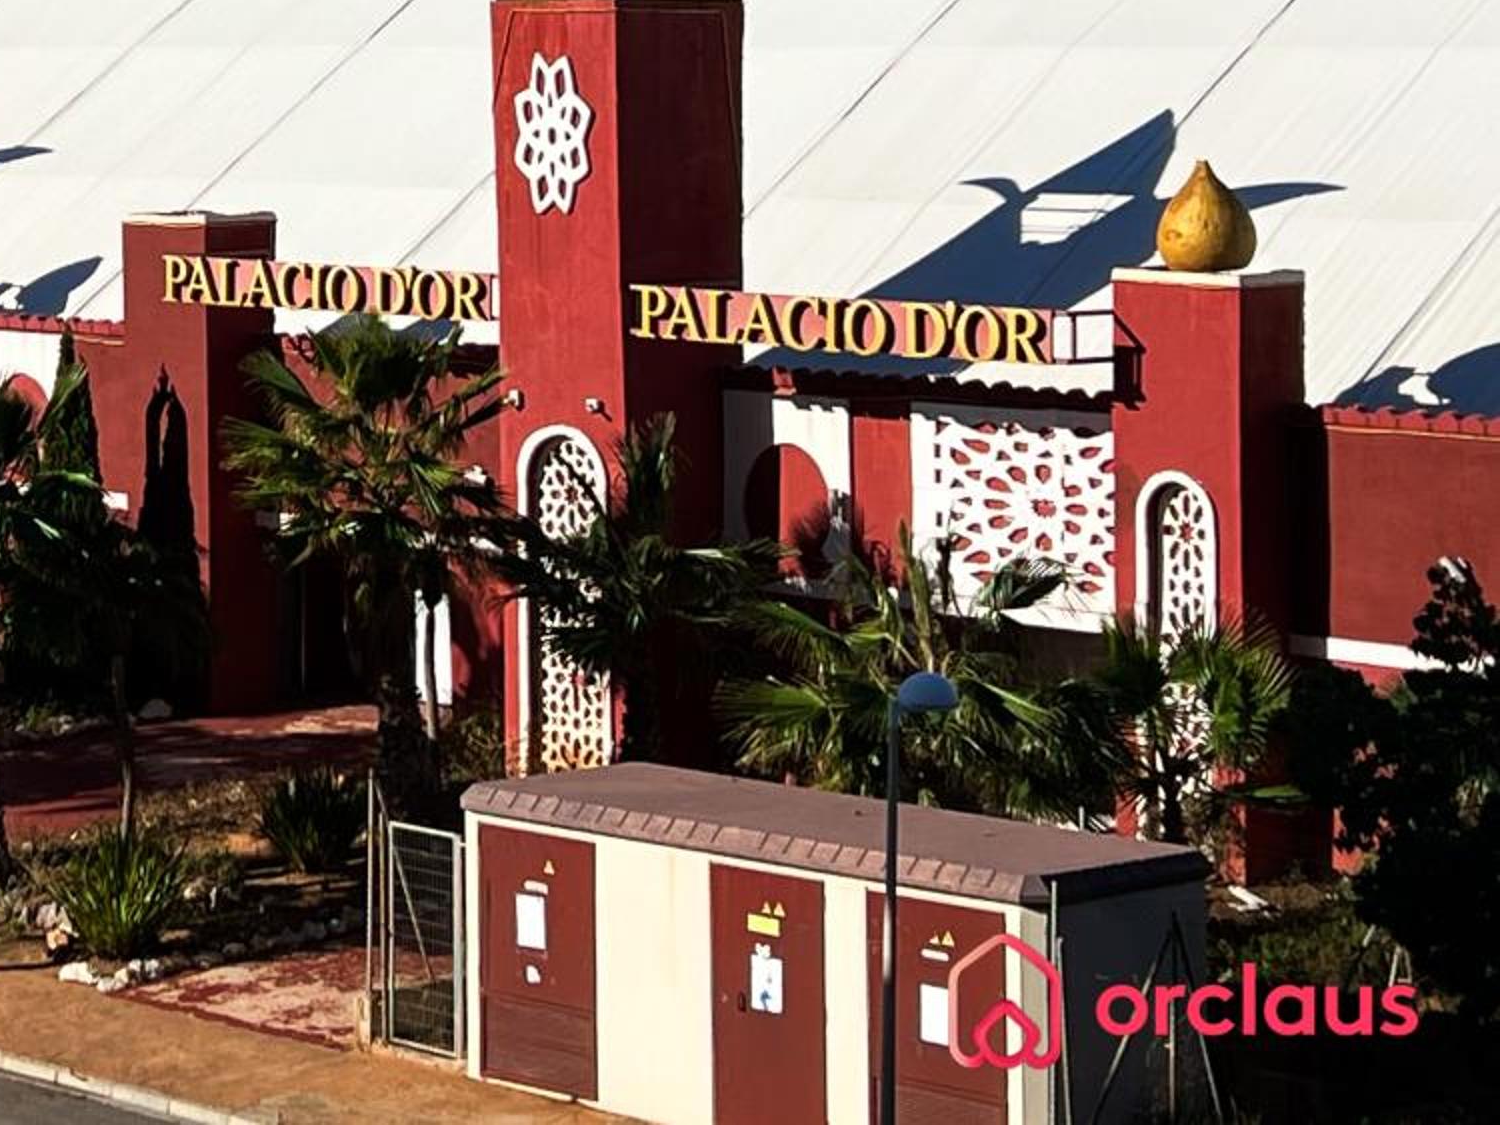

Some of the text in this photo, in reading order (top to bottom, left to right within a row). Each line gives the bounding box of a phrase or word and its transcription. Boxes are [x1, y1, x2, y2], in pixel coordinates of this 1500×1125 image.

[162, 255, 486, 321] PALACIO D'OR
[630, 284, 1046, 363] PALACIO D'OR
